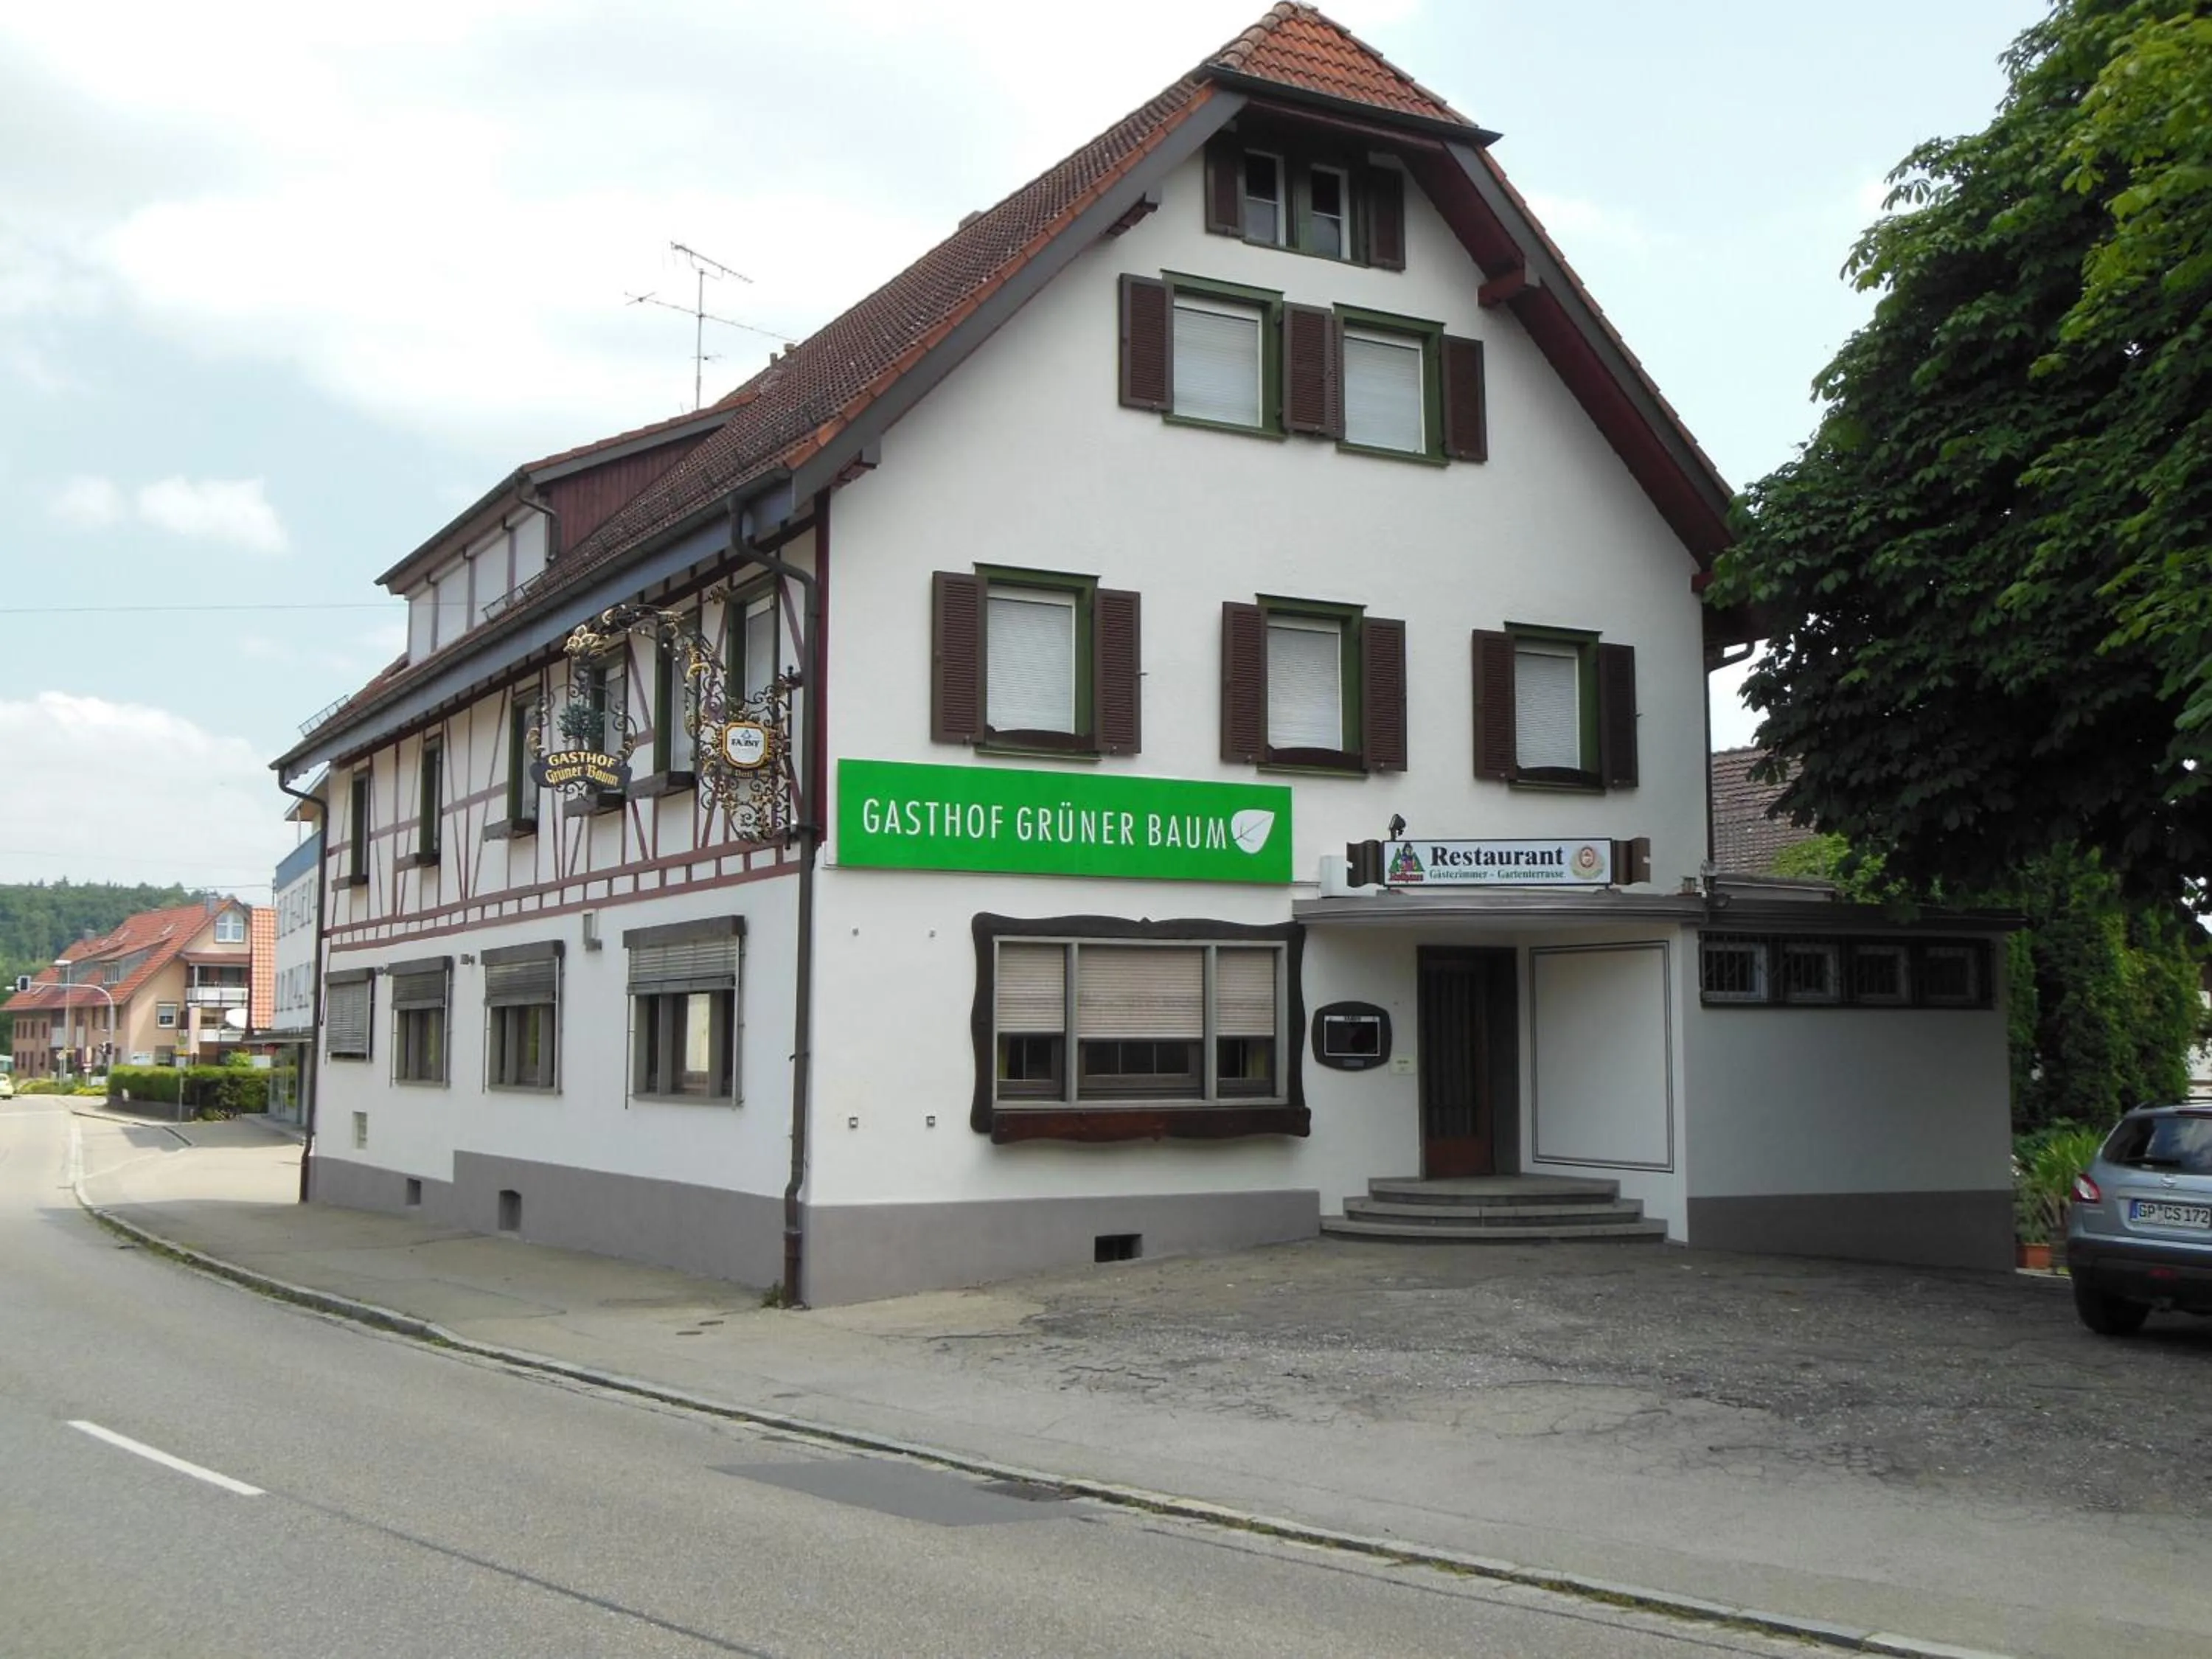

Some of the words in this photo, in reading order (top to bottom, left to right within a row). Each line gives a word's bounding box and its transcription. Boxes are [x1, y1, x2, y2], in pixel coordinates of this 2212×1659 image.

[548, 751, 617, 768] GASTHOF
[587, 764, 619, 787] Baum
[863, 798, 1004, 839] GASTHOF
[1016, 801, 1135, 846] GRÜNER
[1147, 814, 1227, 849] BAUM
[1430, 846, 1564, 866] Restaurant
[1498, 869, 1565, 880] Gartenterrasse
[2139, 1204, 2155, 1218] GP
[2164, 1206, 2181, 1220] CS
[2184, 1208, 2208, 1224] 172
